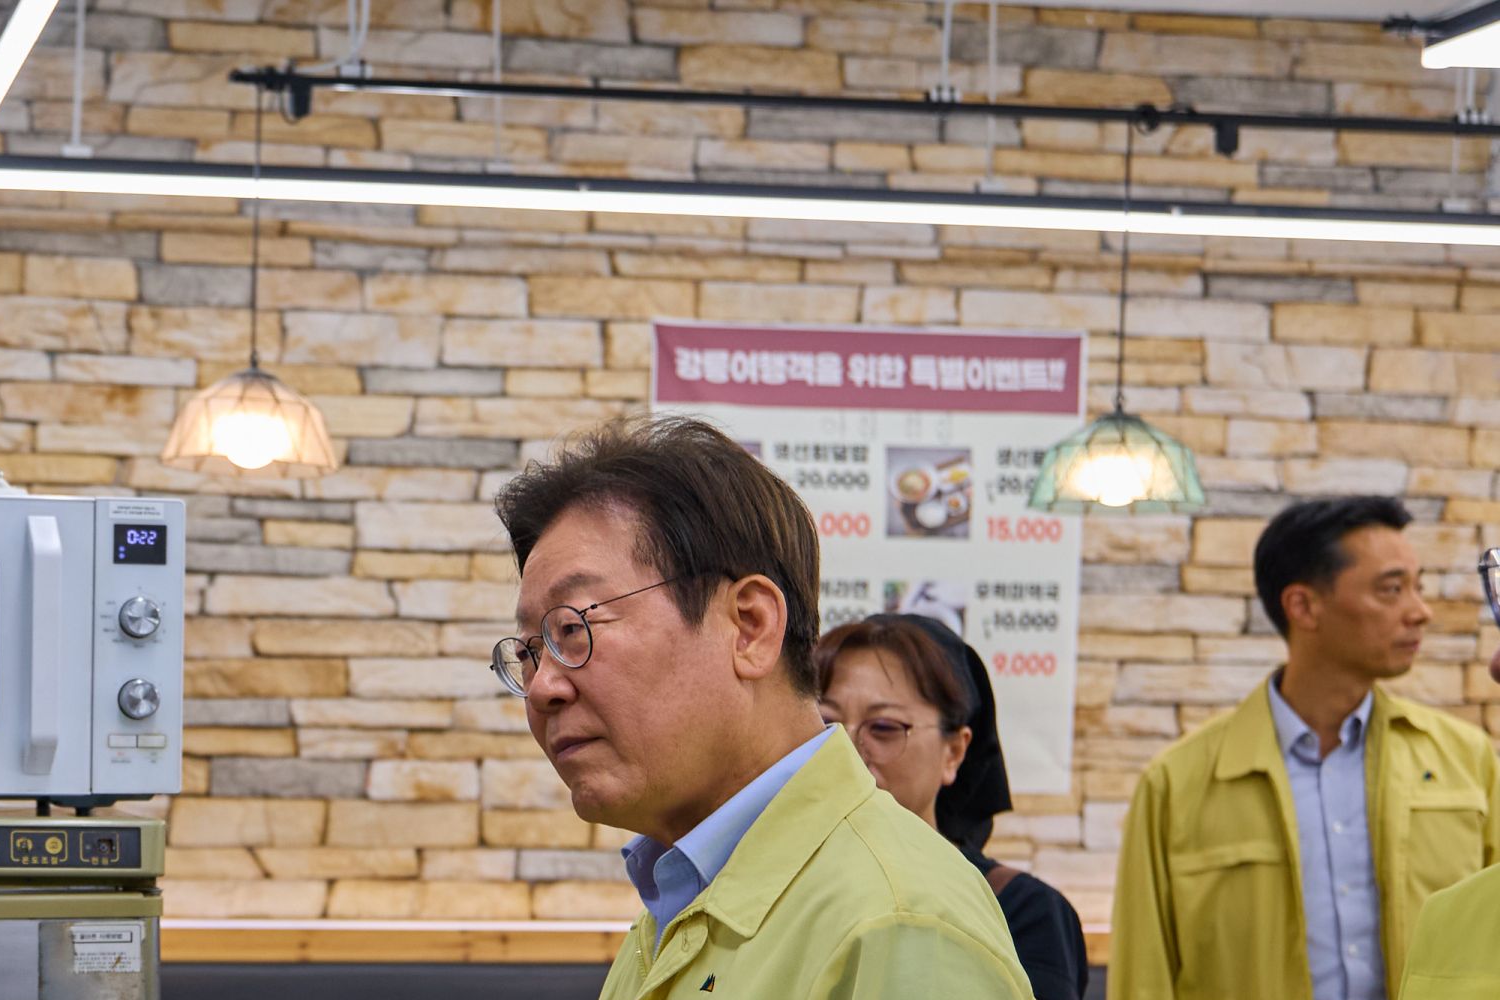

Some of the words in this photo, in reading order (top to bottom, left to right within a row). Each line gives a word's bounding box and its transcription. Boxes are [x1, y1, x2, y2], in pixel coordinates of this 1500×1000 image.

[674, 347, 843, 387] 강릉여행객을
[847, 353, 906, 389] 위한
[909, 355, 1067, 392] 특별이벤트!!
[126, 529, 157, 545] 0:22
